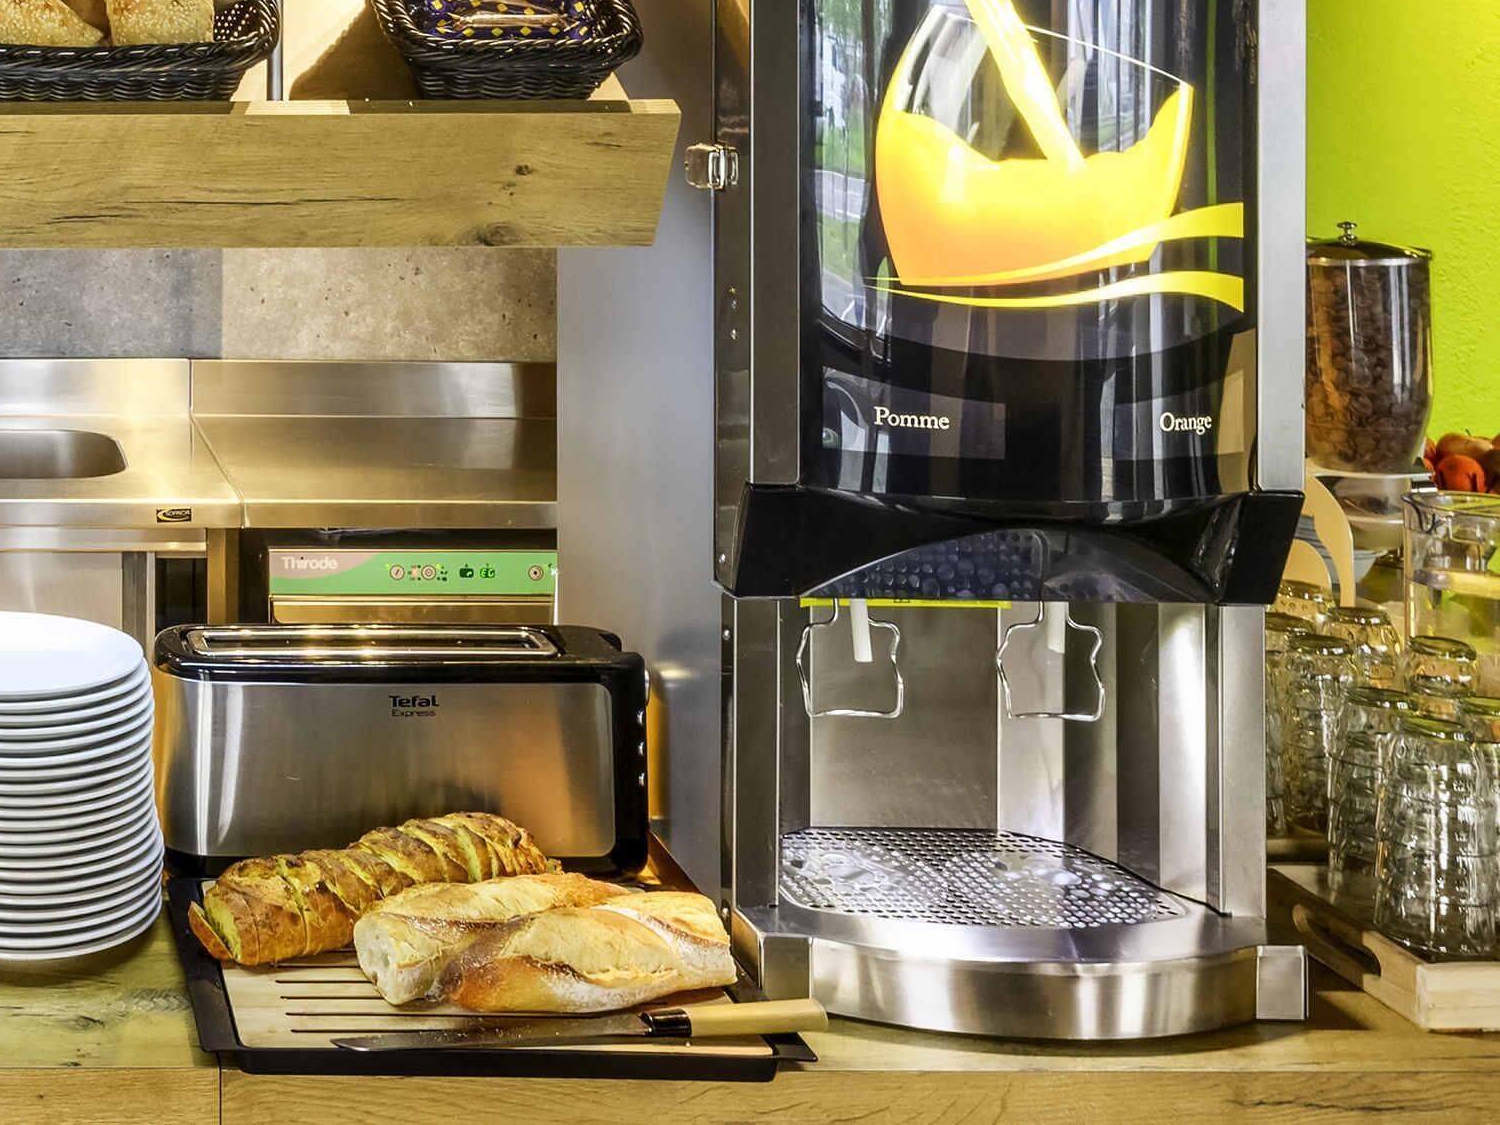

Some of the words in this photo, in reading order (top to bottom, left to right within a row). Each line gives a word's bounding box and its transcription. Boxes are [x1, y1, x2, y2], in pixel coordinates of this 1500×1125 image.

[874, 406, 950, 430] Pomme
[1160, 411, 1212, 435] Orange
[280, 555, 340, 570] Thirode
[388, 694, 440, 708] Tefal
